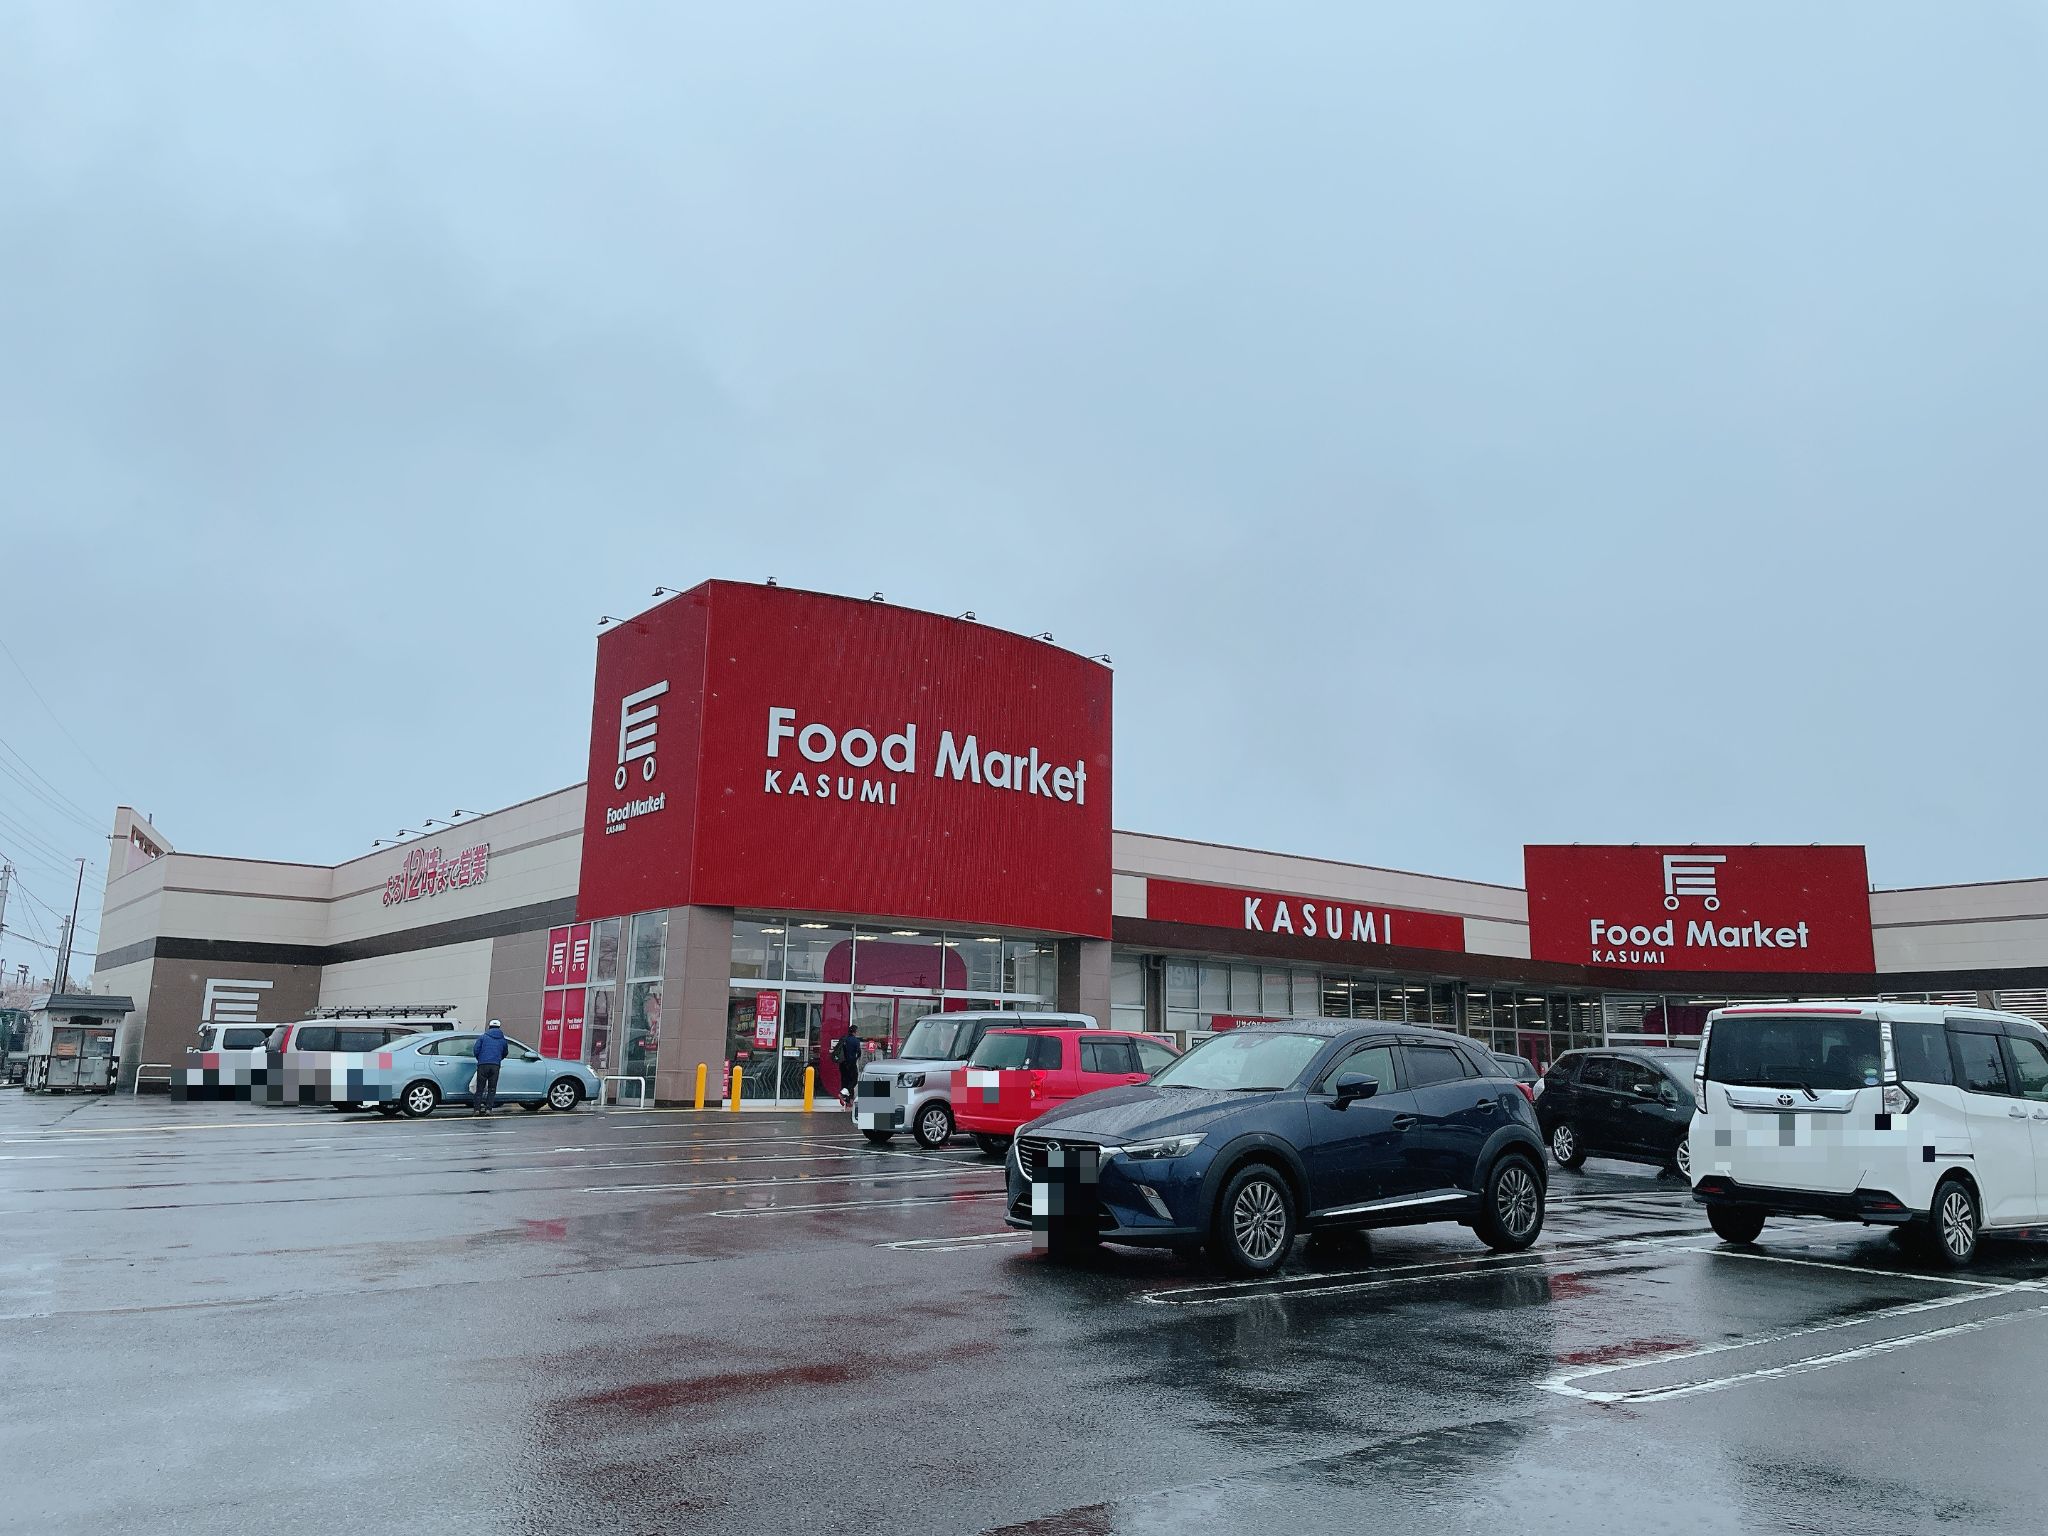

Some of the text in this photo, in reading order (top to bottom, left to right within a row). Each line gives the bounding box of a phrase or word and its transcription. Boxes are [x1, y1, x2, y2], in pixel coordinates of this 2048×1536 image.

[767, 706, 1087, 806] Food Market
[764, 768, 899, 806] KASUMI
[606, 791, 666, 825] Food Market
[382, 842, 489, 907] よる12時まで営業
[1244, 896, 1393, 946] KASUMI
[1590, 918, 1810, 950] Food Market
[1591, 948, 1667, 966] KASUMI
